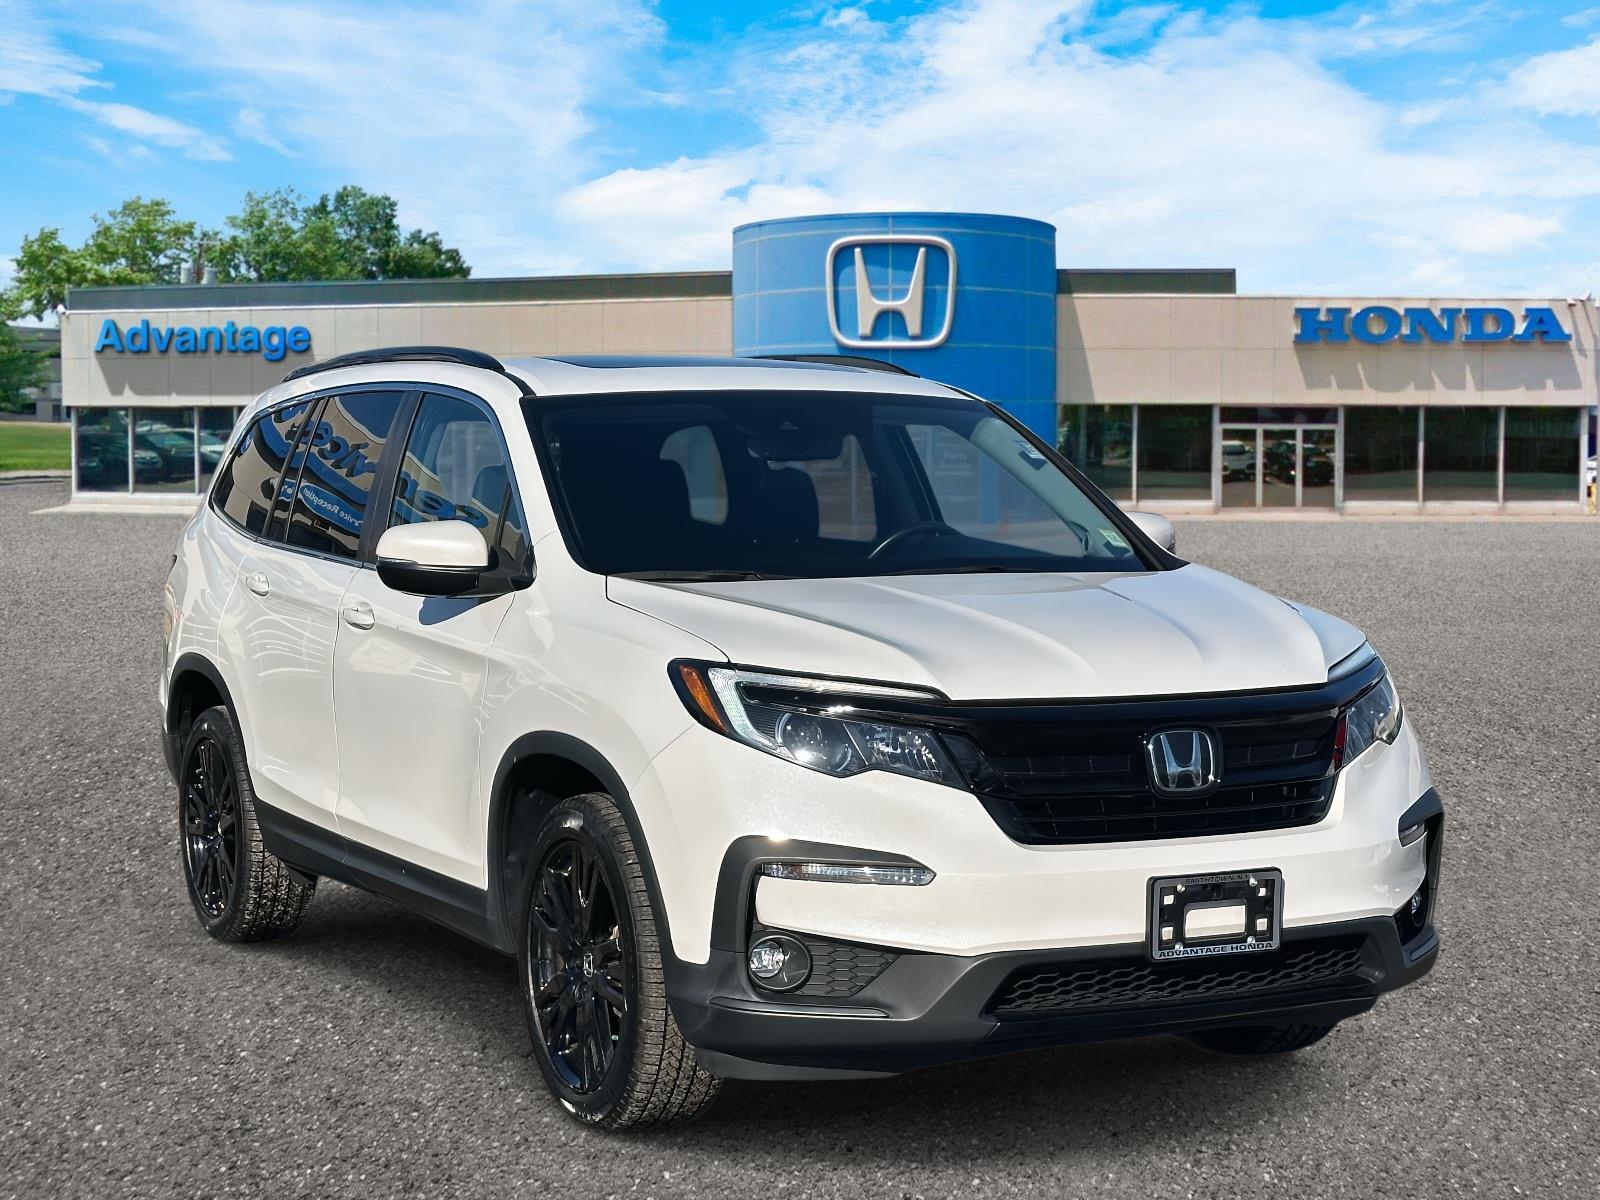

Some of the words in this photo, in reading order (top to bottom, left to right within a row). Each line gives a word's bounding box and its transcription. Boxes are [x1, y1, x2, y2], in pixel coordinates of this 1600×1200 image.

[1294, 305, 1572, 343] HONDA
[95, 318, 312, 362] Advantage
[1185, 874, 1233, 885] SMITHTOWN
[1159, 945, 1229, 958] ADVANTAGE
[1230, 942, 1273, 952] HONDA
